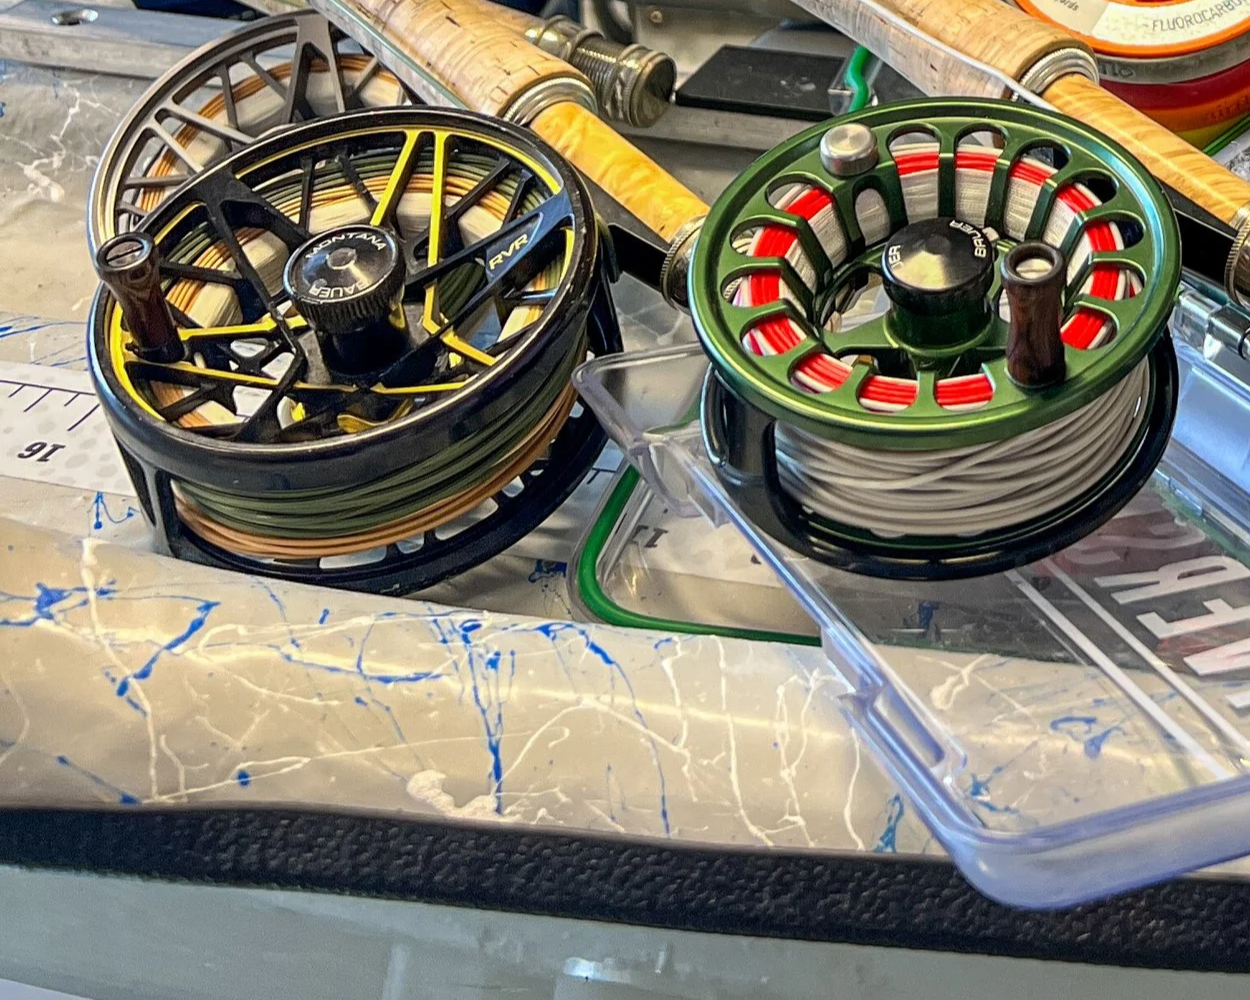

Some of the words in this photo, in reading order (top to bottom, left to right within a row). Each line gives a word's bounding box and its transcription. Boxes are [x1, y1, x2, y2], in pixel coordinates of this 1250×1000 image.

[304, 231, 387, 259] MONTANA
[488, 233, 529, 271] RVR
[949, 219, 987, 258] BAUER
[308, 278, 372, 298] BAUER
[17, 441, 66, 462] 16
